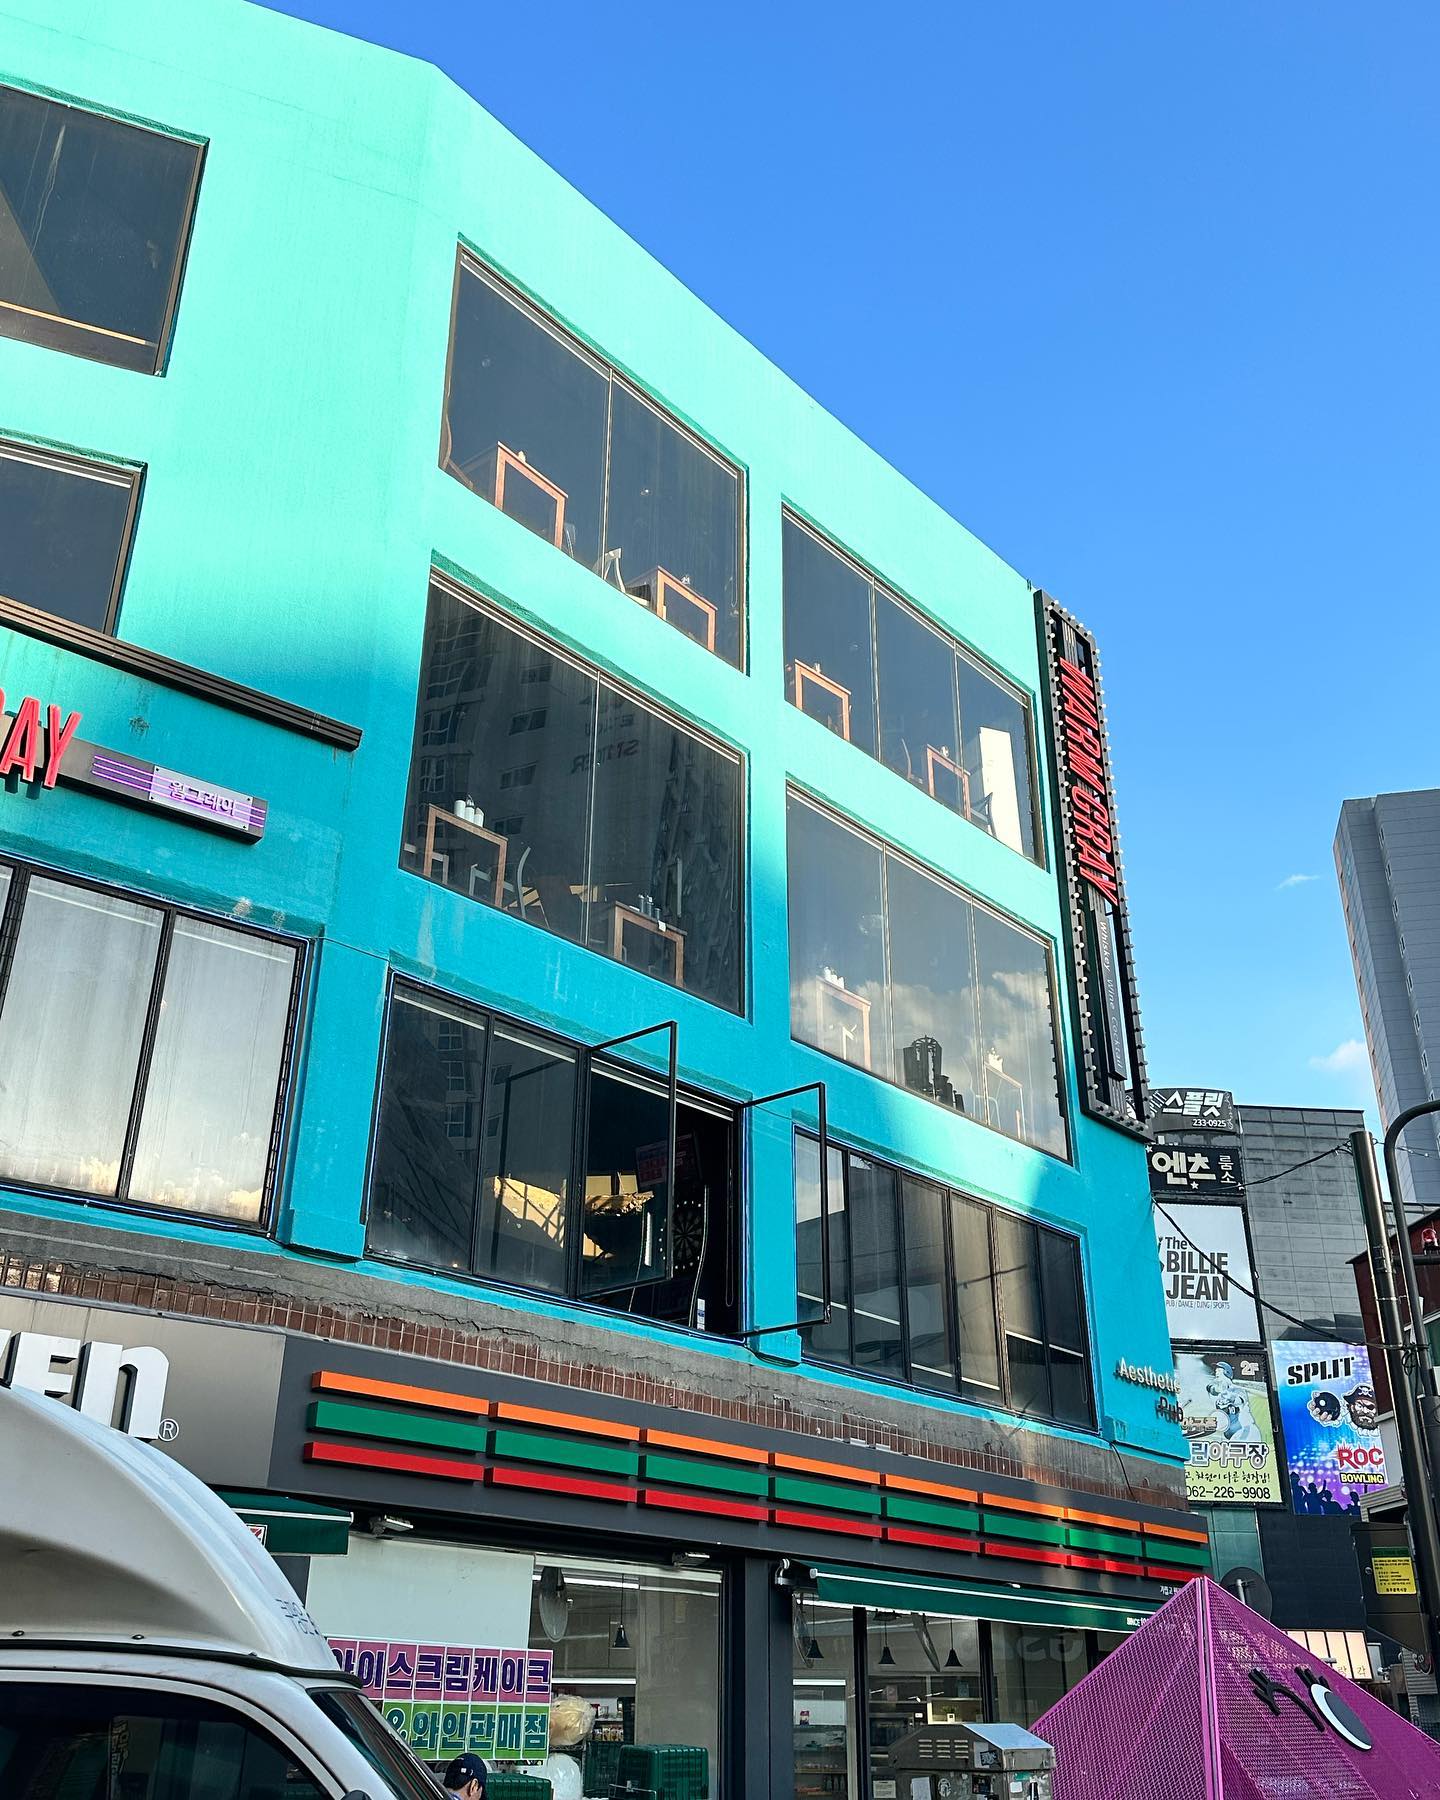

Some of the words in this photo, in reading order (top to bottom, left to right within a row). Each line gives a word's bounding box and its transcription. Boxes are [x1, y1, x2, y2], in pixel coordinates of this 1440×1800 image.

[0, 687, 83, 788] AY
[1059, 656, 1105, 795] WARM
[1071, 785, 1119, 906] GRAY
[1099, 920, 1111, 973] Whiskey
[1106, 978, 1116, 1011] Wine
[1162, 1090, 1224, 1117] 스플릿
[1192, 1118, 1227, 1128] 233-0925
[1165, 1236, 1188, 1250] The
[1166, 1250, 1229, 1275] BILLIE
[1165, 1274, 1229, 1301] JEAN
[1116, 1356, 1182, 1395] Aesthetic
[1240, 1360, 1260, 1376] 2F
[1287, 1356, 1355, 1385] SPLIT
[1156, 1396, 1184, 1424] Pub
[1184, 1441, 1269, 1470] 린야구장
[1336, 1444, 1384, 1470] ROC
[1340, 1473, 1385, 1484] BOWLING
